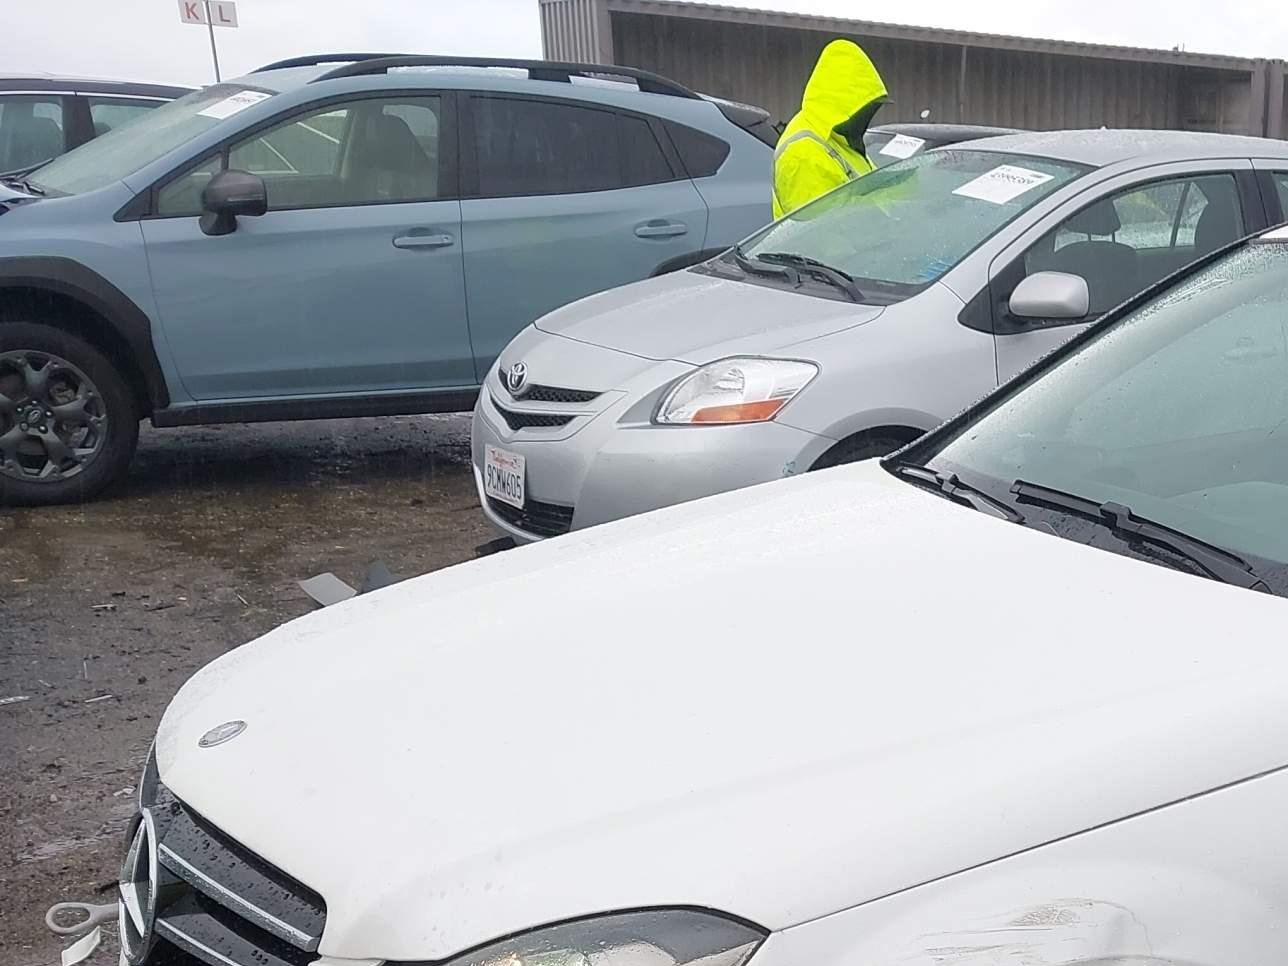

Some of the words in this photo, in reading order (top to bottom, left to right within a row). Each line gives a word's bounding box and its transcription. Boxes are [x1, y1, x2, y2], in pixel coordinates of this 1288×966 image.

[184, 2, 200, 20] K
[218, 4, 231, 22] L
[487, 463, 522, 500] 9CMW605
